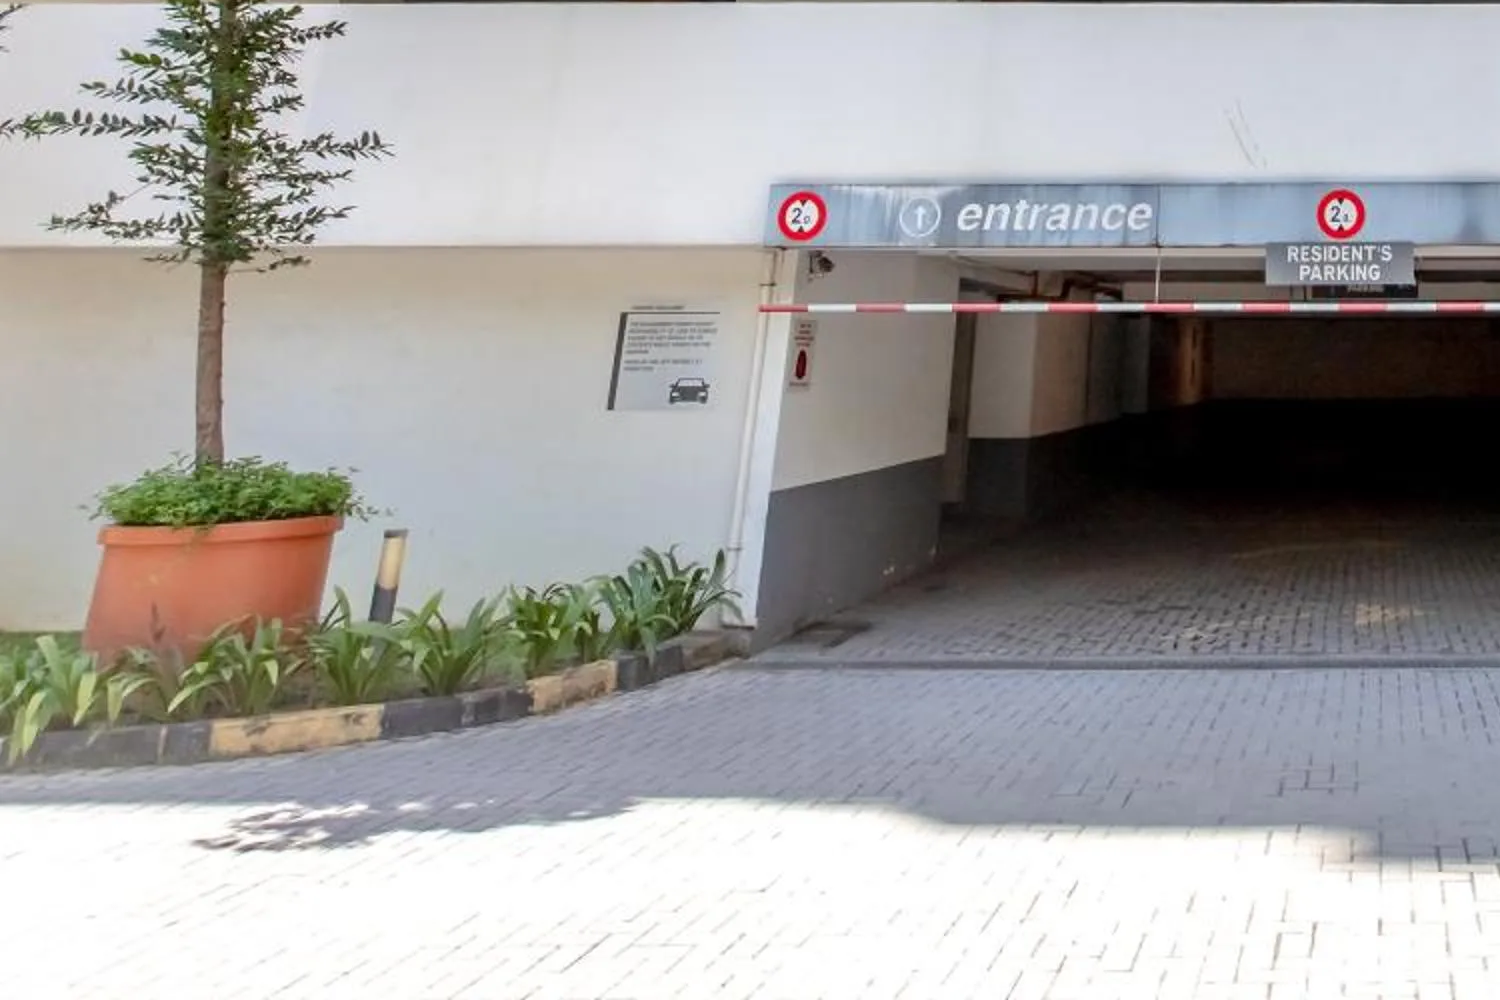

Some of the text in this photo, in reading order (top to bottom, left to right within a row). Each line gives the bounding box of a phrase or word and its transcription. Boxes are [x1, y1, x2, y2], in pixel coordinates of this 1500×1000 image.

[957, 200, 1153, 231] entrance
[1287, 245, 1393, 263] RESIDENT'S
[1299, 264, 1381, 281] PARKING
